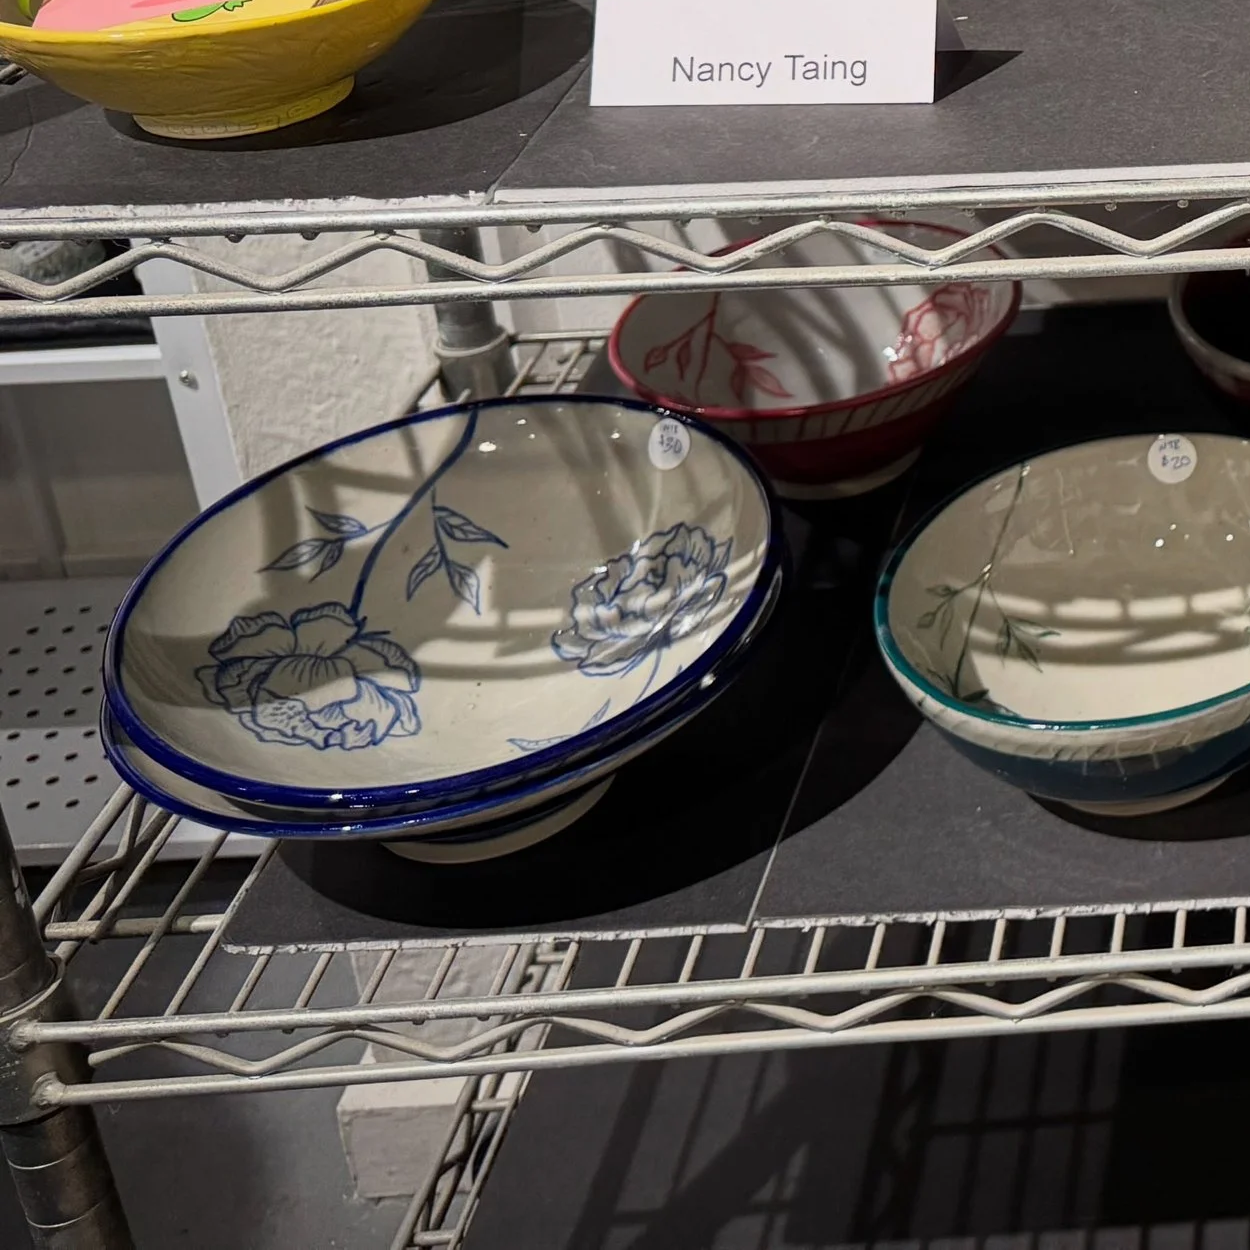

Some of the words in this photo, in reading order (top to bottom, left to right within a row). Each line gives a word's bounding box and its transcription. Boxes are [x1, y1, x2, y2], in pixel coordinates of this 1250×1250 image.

[672, 56, 771, 87] Nancy
[784, 54, 867, 86] Taing
[1162, 454, 1191, 470] $20
